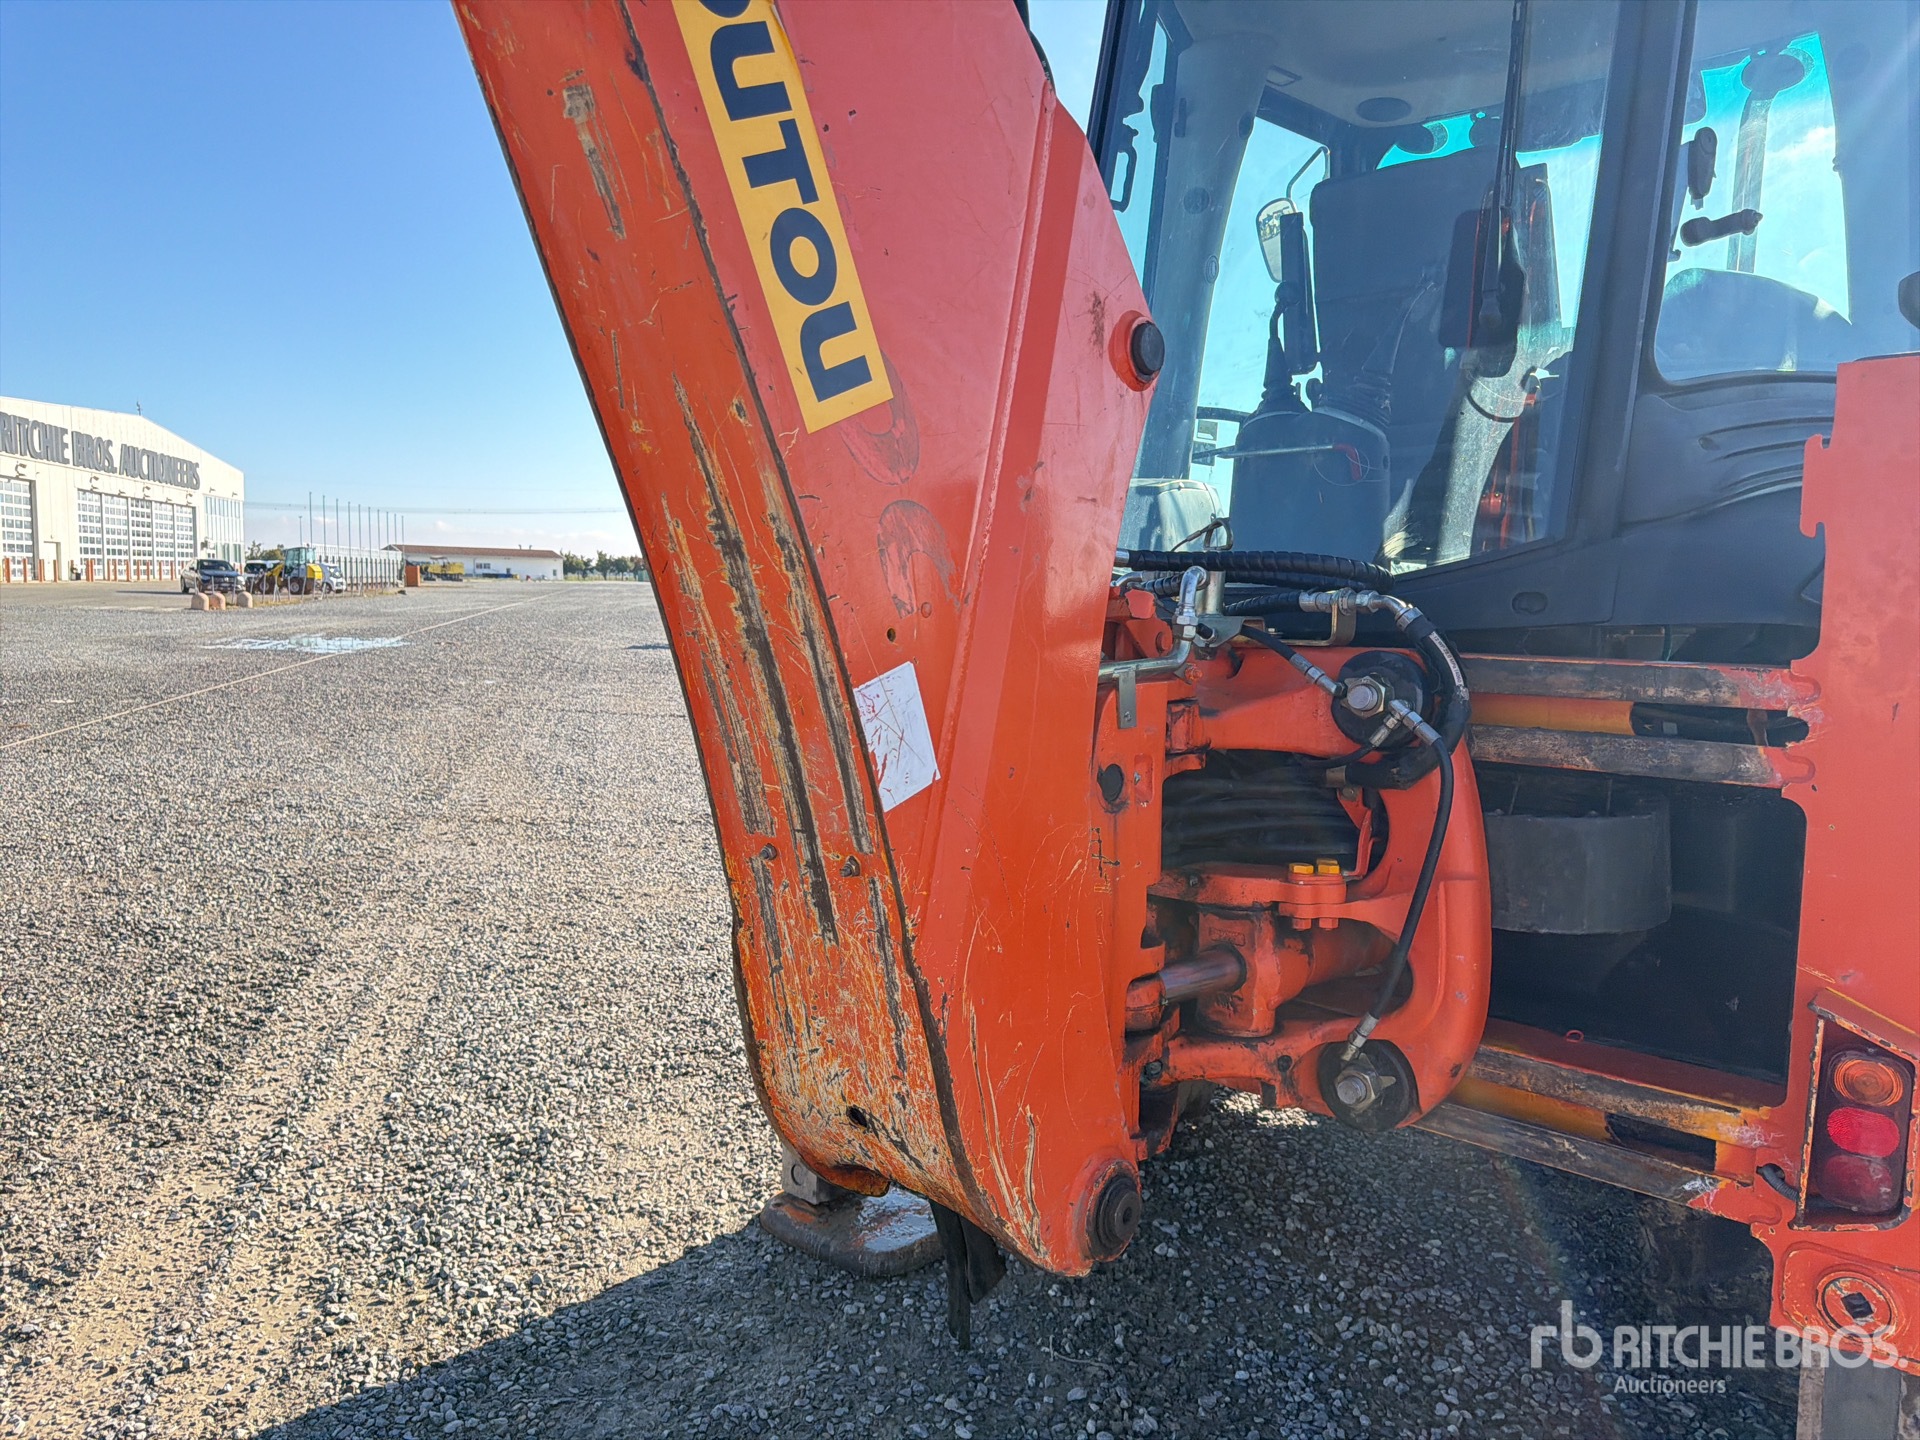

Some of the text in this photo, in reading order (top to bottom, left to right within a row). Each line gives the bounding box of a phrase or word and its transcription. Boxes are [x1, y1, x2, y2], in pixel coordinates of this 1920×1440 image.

[698, 0, 873, 403] UTOU
[0, 411, 201, 490] RITCHIE BROS. AUCTIONEERS
